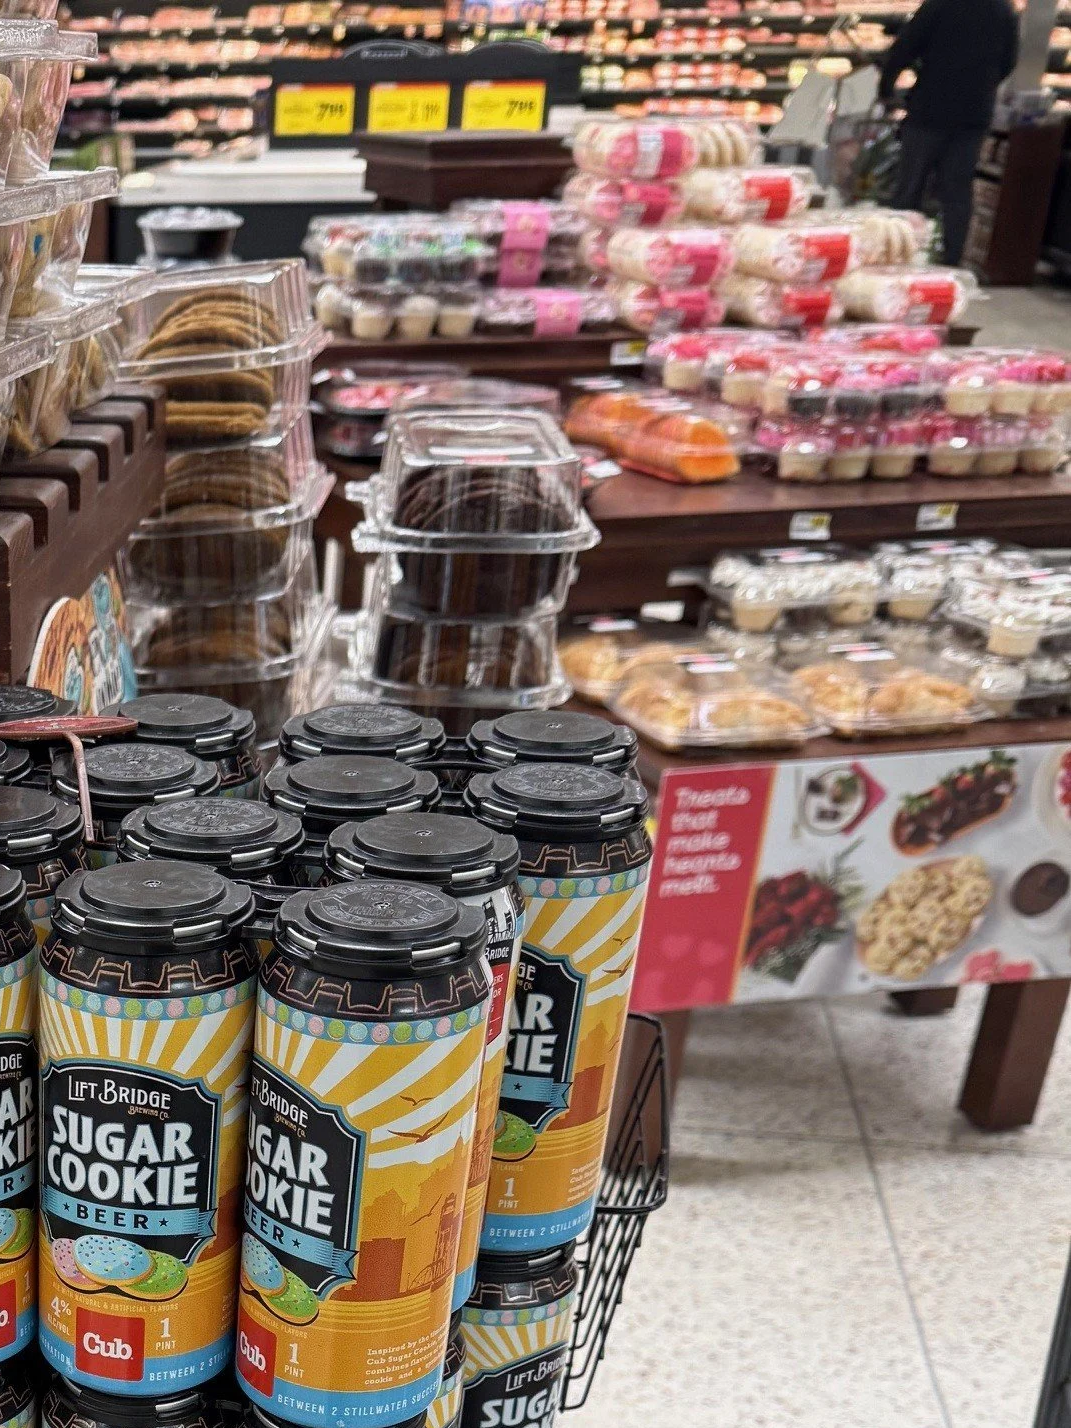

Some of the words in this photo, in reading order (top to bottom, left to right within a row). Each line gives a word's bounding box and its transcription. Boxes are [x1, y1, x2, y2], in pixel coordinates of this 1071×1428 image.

[675, 786, 752, 808] Treats
[671, 811, 719, 832] that
[667, 832, 729, 854] make
[664, 853, 742, 875] hearts
[660, 874, 720, 898] melt.
[68, 1075, 98, 1101] LIFT
[98, 1079, 171, 1110] BRIDGE
[259, 1079, 309, 1128] BRIDGE
[52, 1105, 195, 1165] SUGAR
[248, 1105, 329, 1187] UGAR
[47, 1144, 200, 1206] COOKIE
[504, 1177, 515, 1197] 1
[498, 1199, 519, 1208] PINT
[76, 1203, 149, 1229] BEER
[489, 1227, 536, 1238] BETWEEN
[540, 1227, 546, 1236] 2
[51, 1296, 72, 1318] 4%
[160, 1318, 171, 1338] 1
[83, 1332, 133, 1360] Cub
[155, 1340, 176, 1350] PINT
[240, 1331, 266, 1372] Cub
[289, 1343, 299, 1364] 1
[367, 1343, 406, 1356] Inspired
[407, 1340, 417, 1350] by
[418, 1335, 429, 1344] the
[365, 1363, 409, 1375] combines
[367, 1356, 386, 1365] Cub
[388, 1352, 412, 1362] Sugar
[149, 1366, 195, 1381] BETWEEN
[284, 1365, 304, 1378] PINT
[364, 1376, 393, 1385] cookie
[398, 1370, 413, 1379] and
[506, 1370, 535, 1392] LIFT
[277, 1394, 325, 1414] BETWEEN
[331, 1406, 337, 1415] 2
[344, 1399, 407, 1416] STILLWATER
[480, 1379, 560, 1428] SUGA
